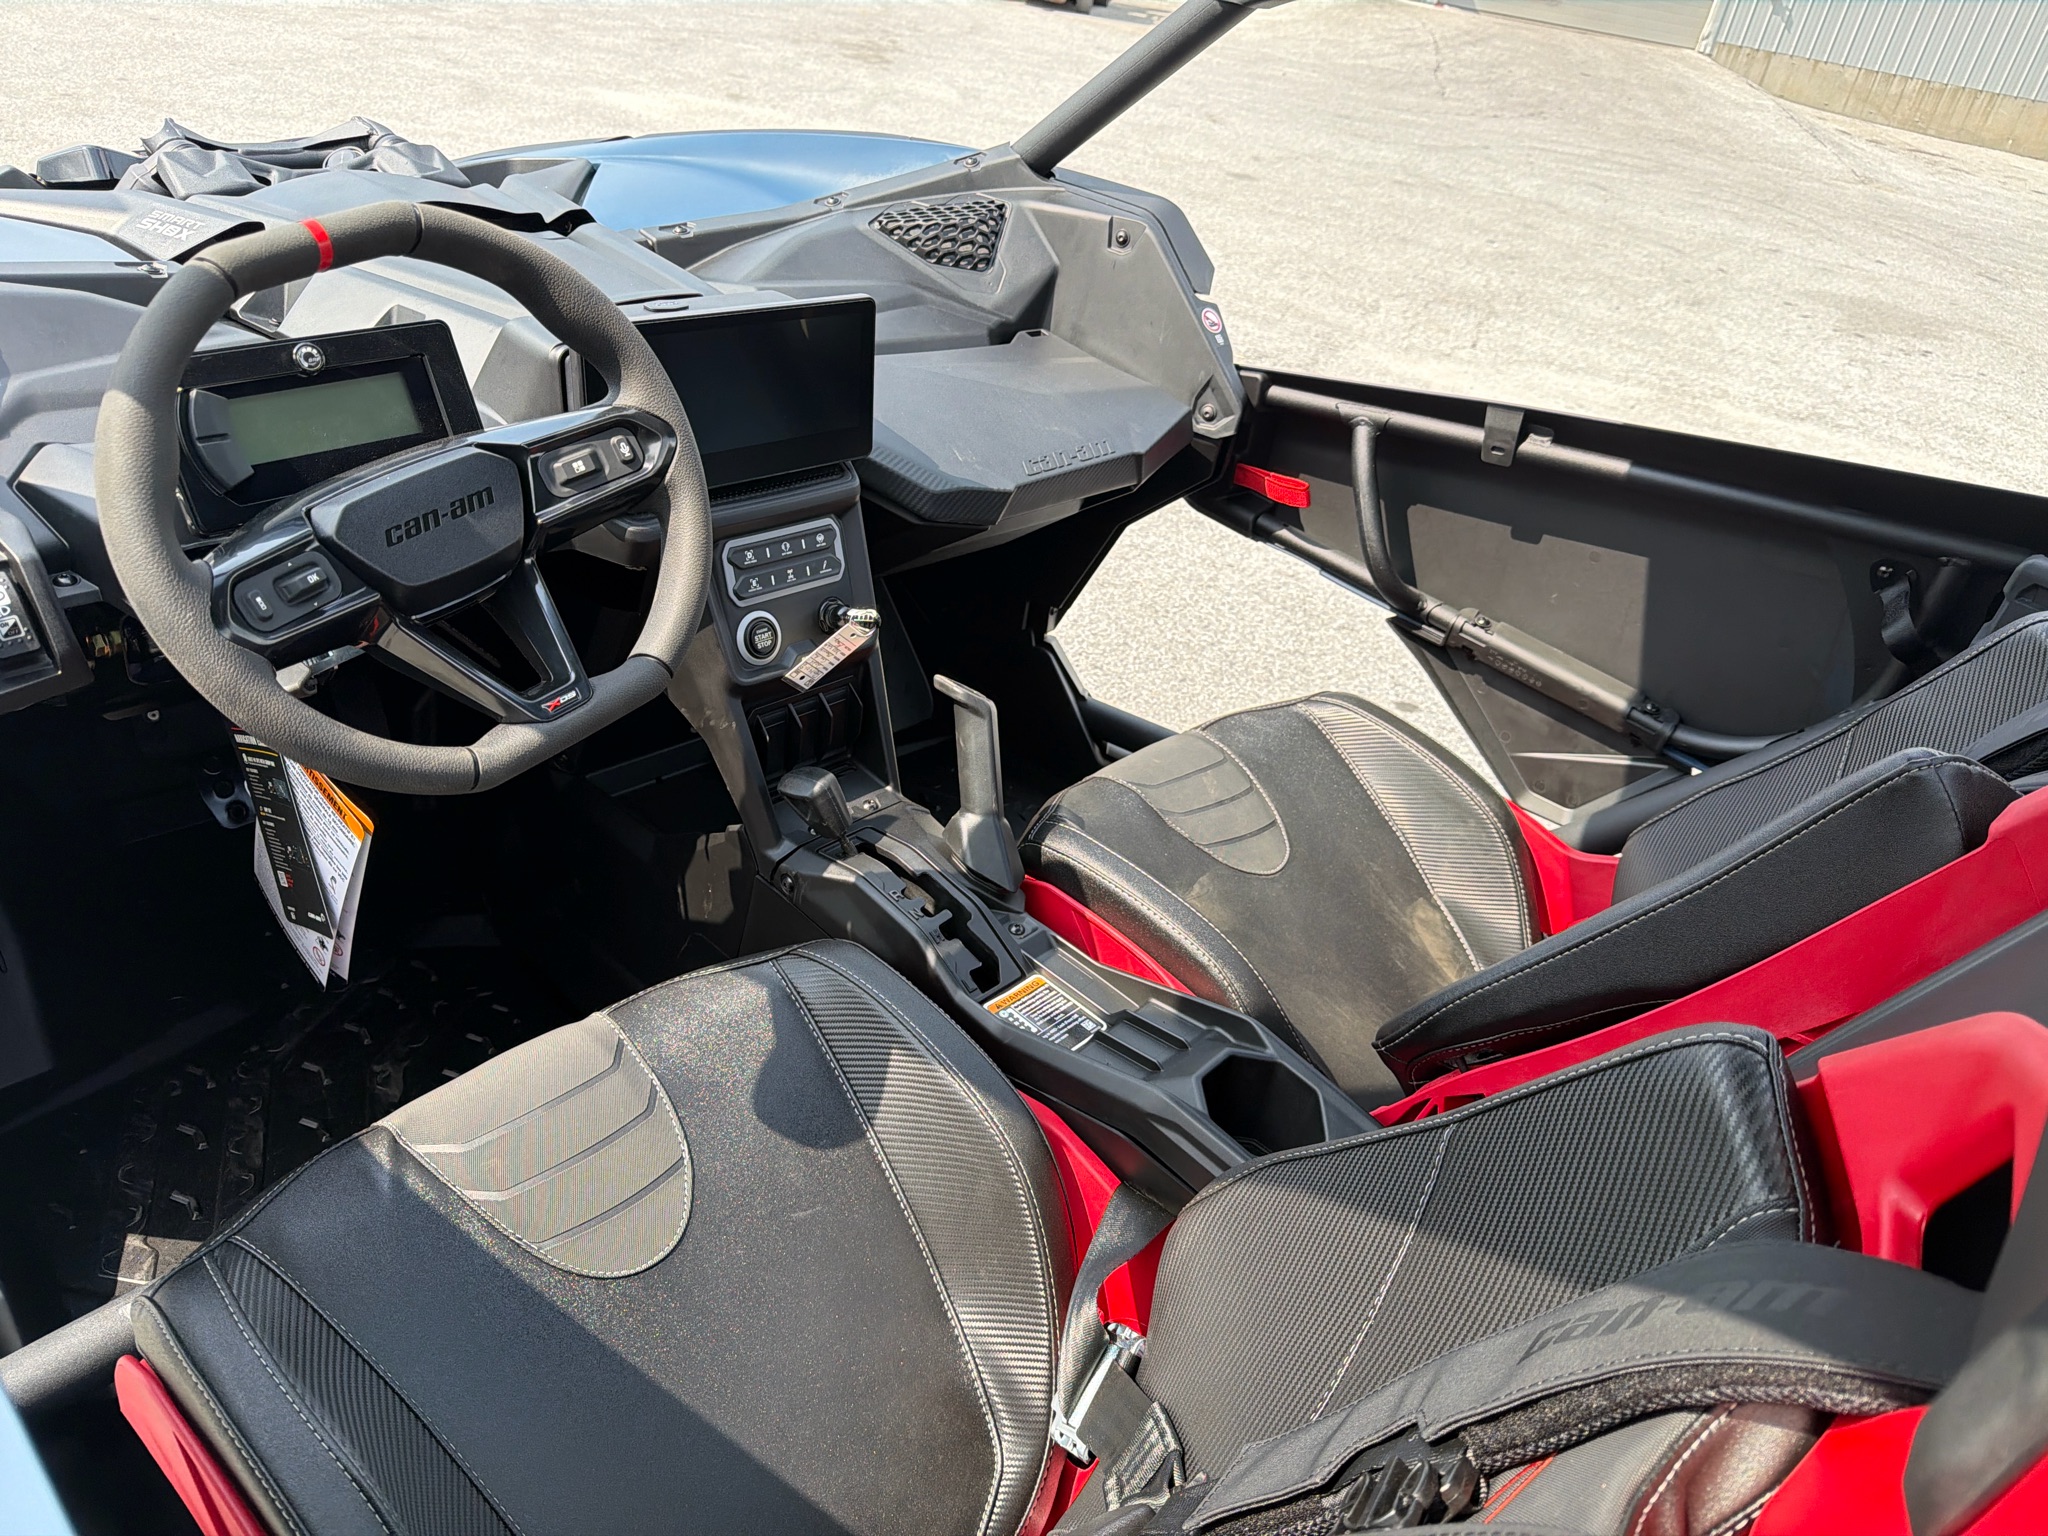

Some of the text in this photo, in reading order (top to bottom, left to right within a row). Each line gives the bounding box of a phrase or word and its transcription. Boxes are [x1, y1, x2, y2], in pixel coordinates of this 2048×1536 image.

[148, 210, 205, 229] SMART
[1022, 439, 1116, 476] can-am
[385, 486, 495, 548] can-am
[307, 573, 320, 584] OK
[755, 631, 772, 641] START
[757, 640, 772, 649] STOP
[888, 889, 905, 902] R
[908, 907, 924, 921] N
[1001, 980, 1040, 1005] WARNING
[1516, 1280, 1843, 1366] can-am
